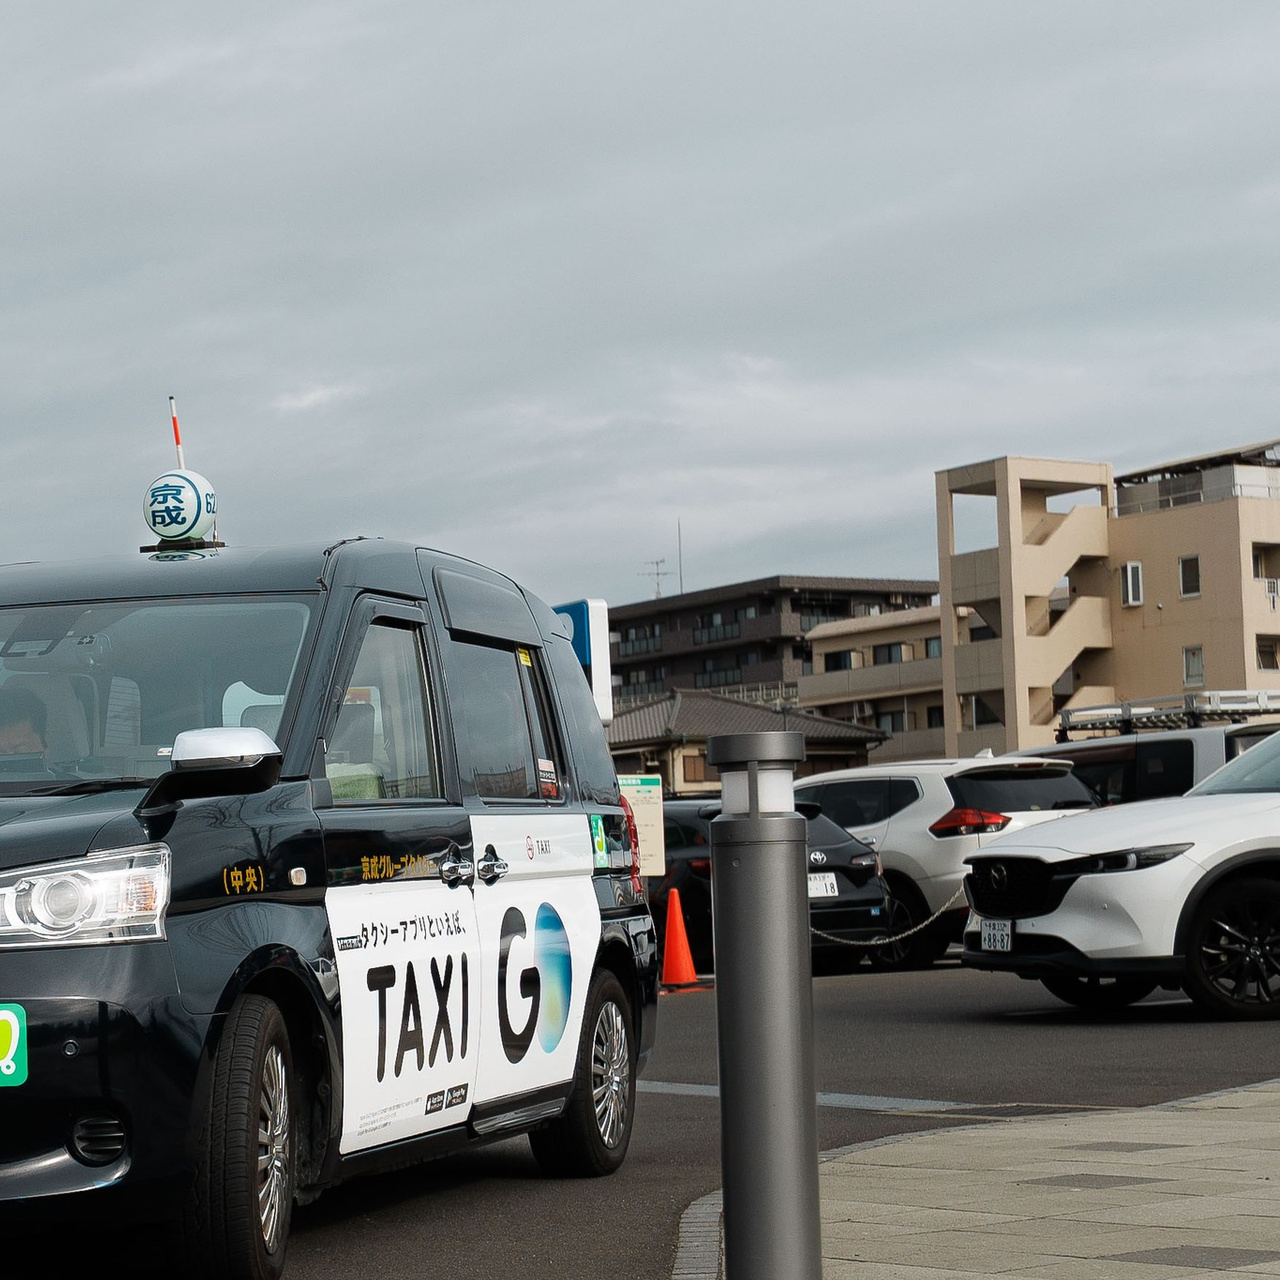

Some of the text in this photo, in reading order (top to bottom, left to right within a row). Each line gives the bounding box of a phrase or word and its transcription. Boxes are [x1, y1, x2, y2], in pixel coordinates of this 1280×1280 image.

[149, 483, 187, 527] 京成
[536, 840, 551, 855] TAXI
[361, 910, 466, 949] タクシーアプリといえば、
[367, 902, 573, 1083] TAXI GO
